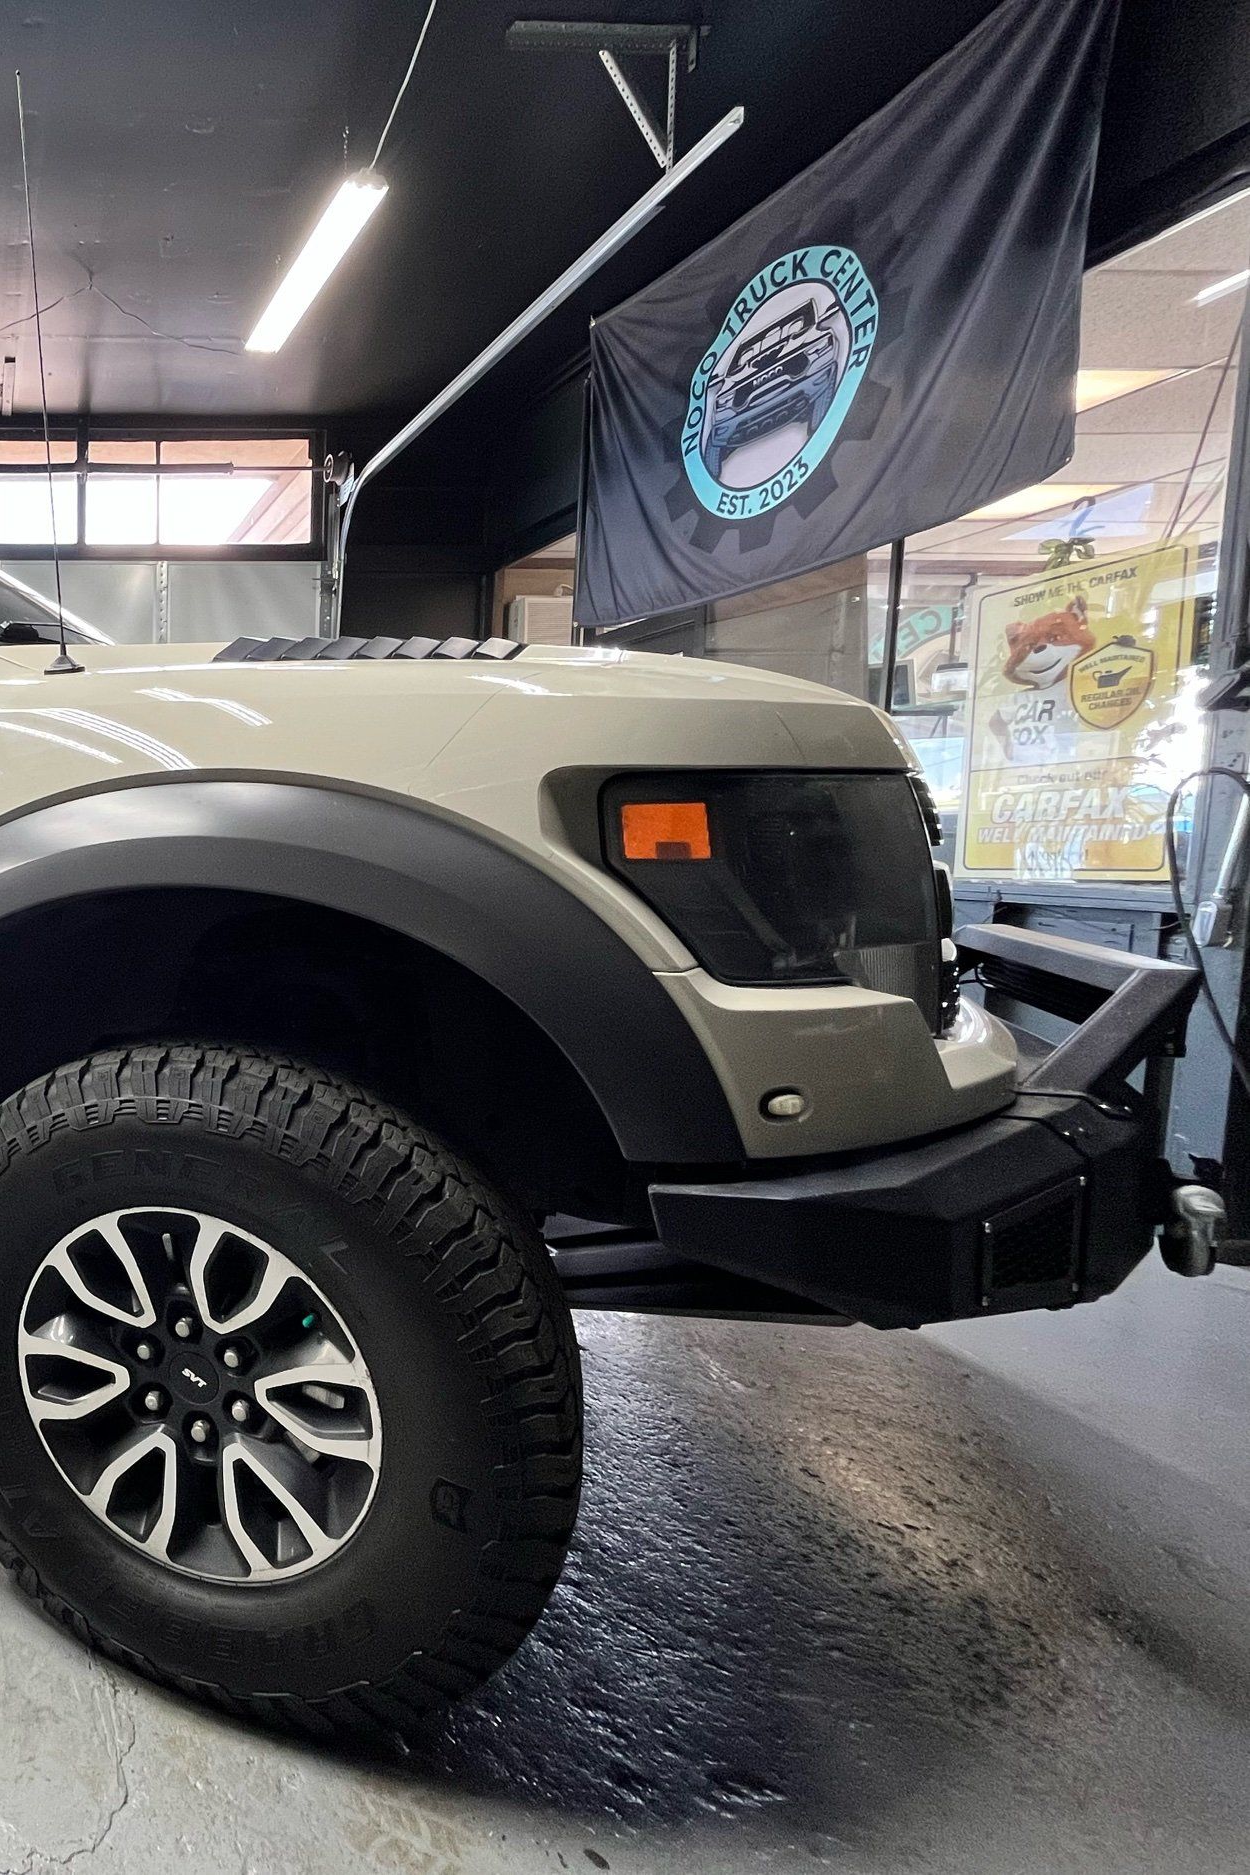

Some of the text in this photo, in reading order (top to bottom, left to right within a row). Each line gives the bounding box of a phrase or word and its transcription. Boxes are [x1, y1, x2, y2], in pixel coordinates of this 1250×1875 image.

[683, 249, 875, 456] NOCO TRUCK CENTER
[716, 456, 809, 516] EST. 2023
[1013, 590, 1046, 607] SHOW
[1047, 585, 1065, 598] ME
[1089, 565, 1140, 588] CARFAX
[1010, 699, 1055, 724] CAR
[1017, 773, 1055, 785] Check
[993, 788, 1127, 823] CARFAX
